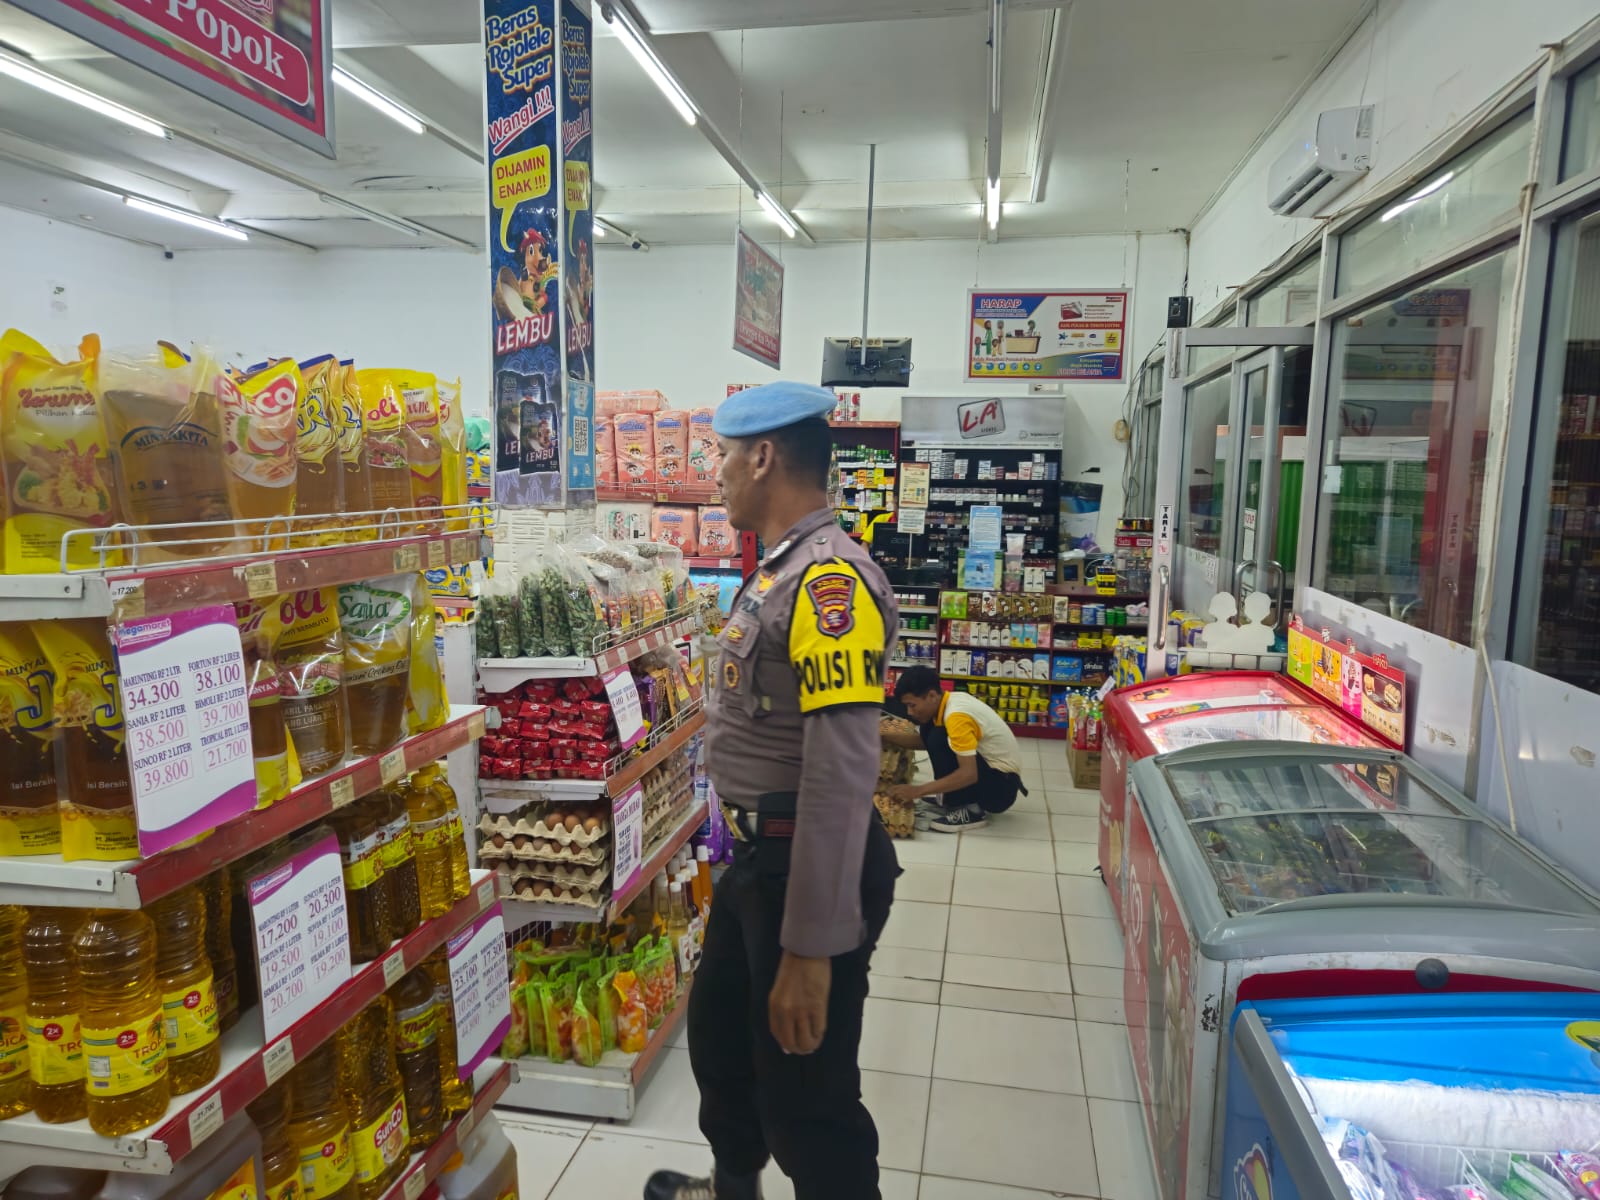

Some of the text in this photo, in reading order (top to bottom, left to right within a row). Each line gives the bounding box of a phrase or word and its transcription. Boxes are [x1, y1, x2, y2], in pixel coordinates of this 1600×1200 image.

[486, 6, 537, 42] Beras
[561, 18, 584, 41] Beras
[166, 0, 286, 80] Popok
[487, 27, 552, 70] Rojolele
[503, 56, 552, 91] Super
[488, 99, 534, 143] Wangi
[496, 155, 546, 181] DIJAMIN
[498, 180, 532, 200] ENAK
[980, 299, 1023, 309] HARAP
[496, 311, 554, 355] LEMBU
[567, 321, 593, 352] LEMBU
[525, 447, 555, 463] LEMBU
[1161, 506, 1169, 539] TARIK
[195, 664, 240, 691] 38.100
[127, 680, 180, 710] 34.300
[165, 704, 186, 718] LITER
[203, 701, 244, 728] 39.700
[136, 719, 185, 752] 38.500
[172, 743, 192, 756] LITER
[208, 738, 247, 768] 21.700
[144, 759, 189, 792] 39.800
[309, 886, 341, 918] 20.300
[261, 914, 298, 949] 17.200
[313, 917, 343, 947] 19.100
[266, 946, 300, 981] 19.500
[315, 948, 346, 979] 19.200
[271, 979, 303, 1014] 20.700
[375, 1108, 402, 1144] SunCo
